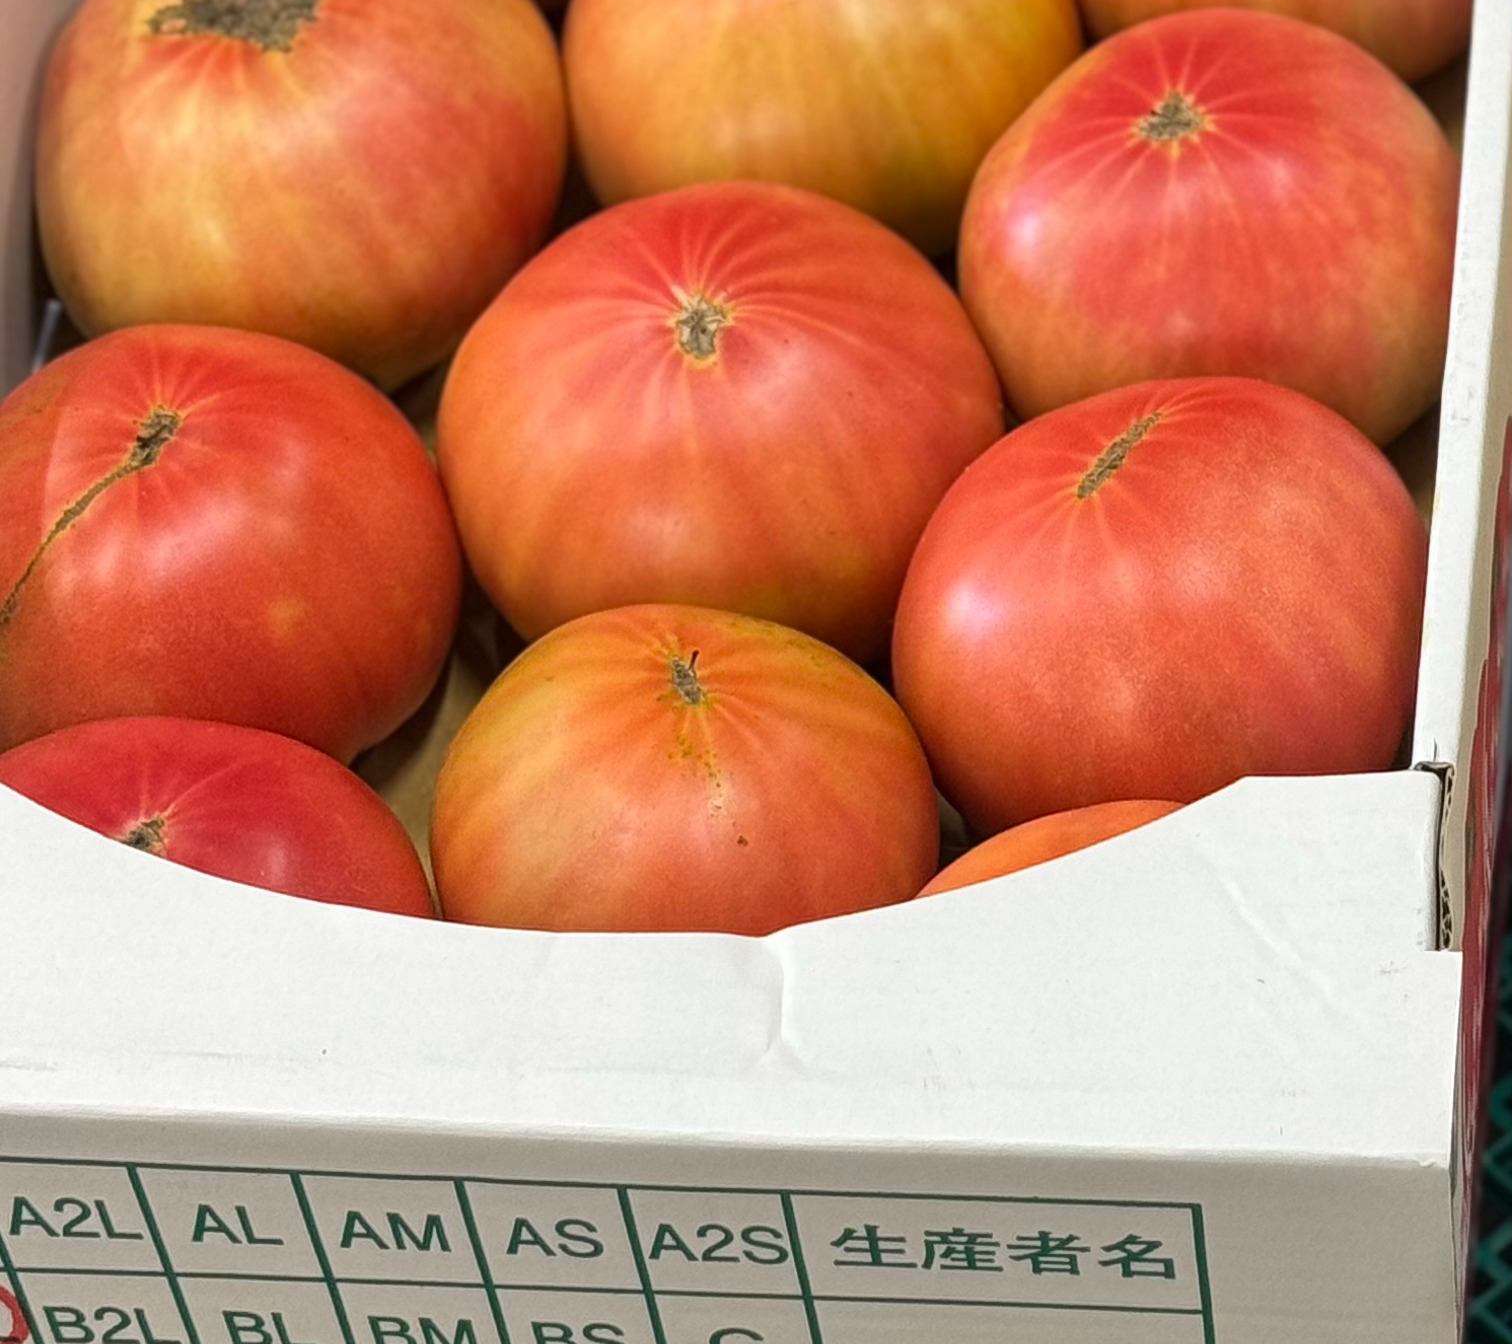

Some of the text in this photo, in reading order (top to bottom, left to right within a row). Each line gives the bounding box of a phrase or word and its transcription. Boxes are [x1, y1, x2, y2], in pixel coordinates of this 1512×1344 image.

[9, 1196, 1177, 1280] A2L AL AM AS A2S 生産者名
